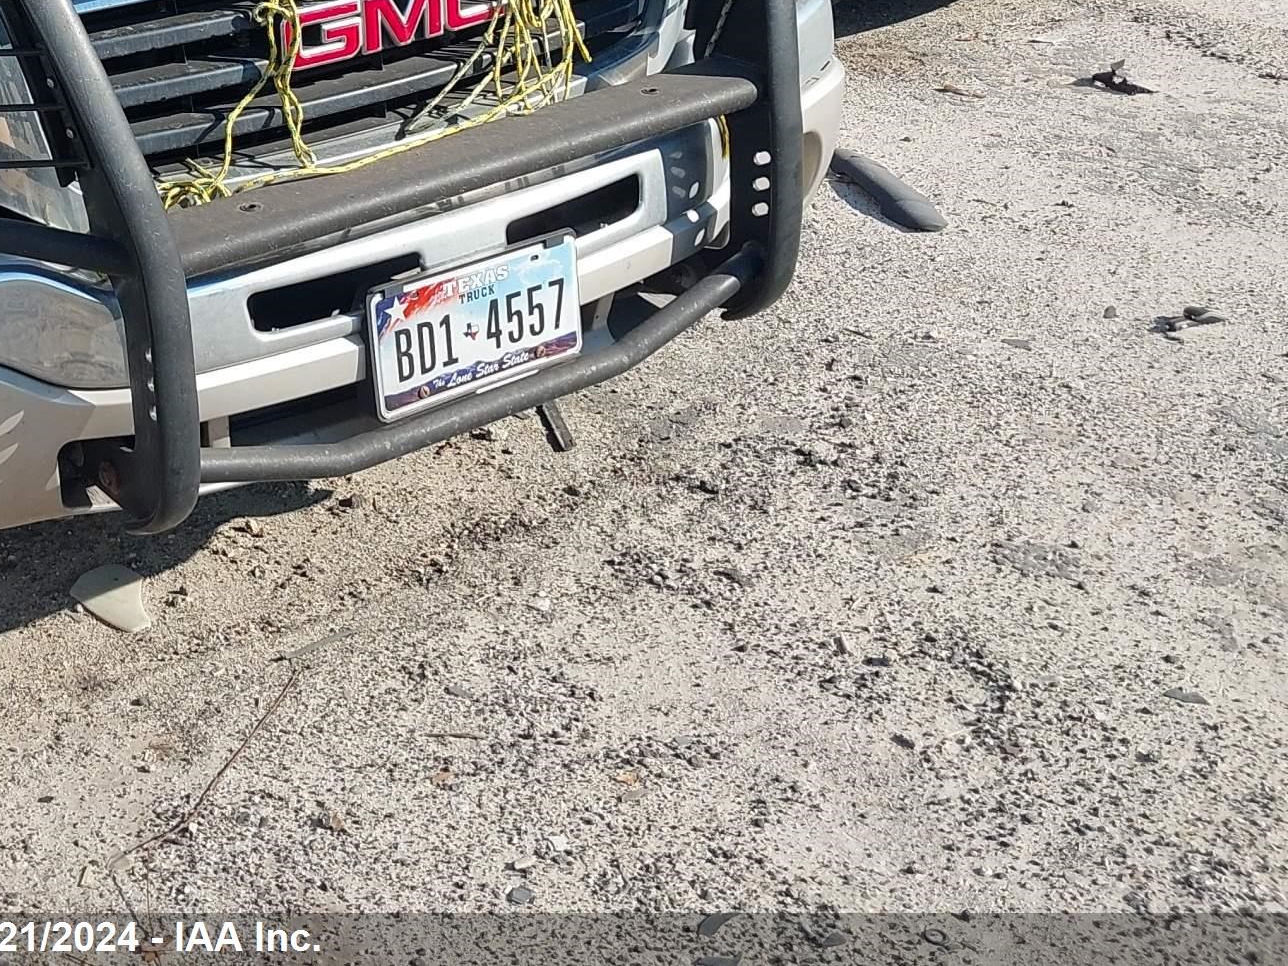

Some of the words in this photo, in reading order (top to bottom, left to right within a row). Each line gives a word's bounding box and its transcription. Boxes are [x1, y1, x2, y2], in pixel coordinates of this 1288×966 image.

[441, 265, 510, 297] TEXAS
[458, 283, 496, 305] TRUCK
[394, 313, 460, 384] BD1
[486, 277, 565, 349] 4557
